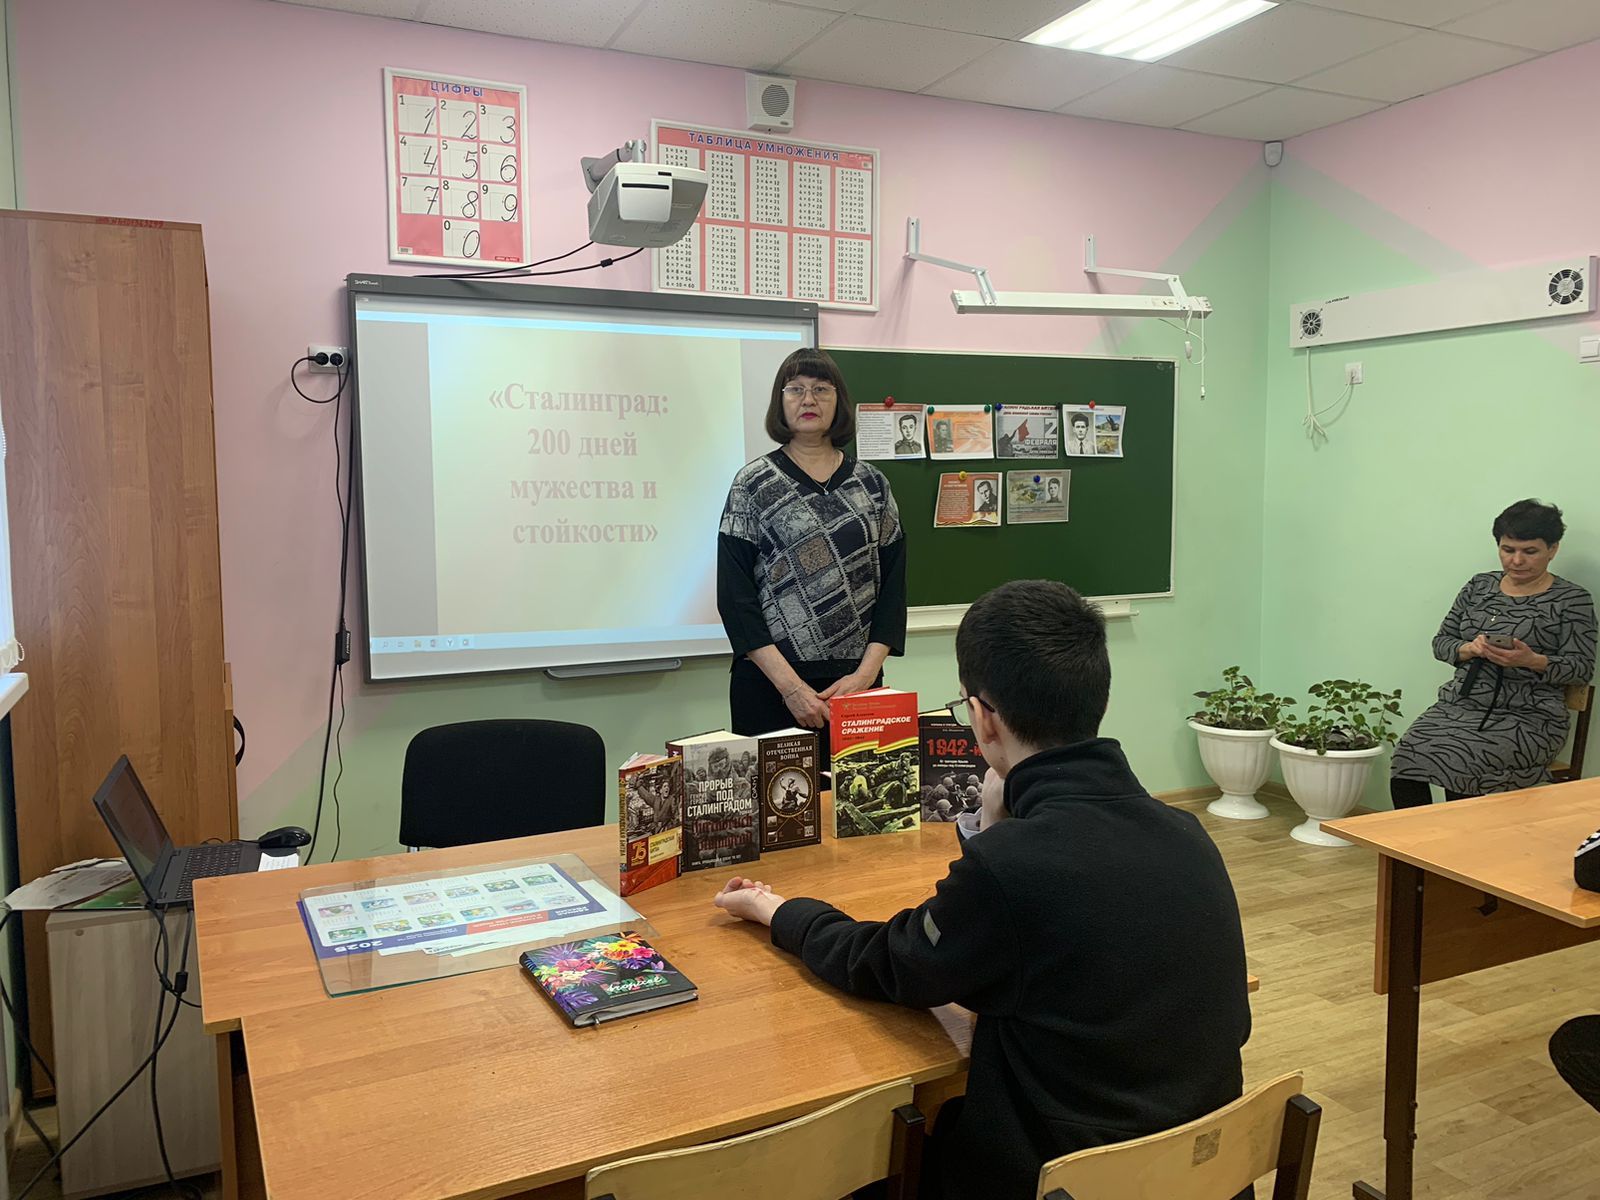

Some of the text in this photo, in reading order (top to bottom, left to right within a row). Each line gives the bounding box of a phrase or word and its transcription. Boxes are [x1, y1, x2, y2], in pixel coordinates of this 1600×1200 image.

[431, 81, 484, 97] ЦИФРЫ
[400, 95, 405, 105] 1
[440, 100, 447, 110] 2
[480, 105, 487, 115] 3
[424, 106, 437, 134] 1
[461, 110, 478, 140] 2
[500, 115, 516, 144] 3
[400, 136, 407, 146] 4
[442, 140, 448, 150] 5
[481, 145, 488, 154] 6
[688, 132, 840, 161] ТАБЛИЦА УМНОЖЕНИЯ
[424, 145, 438, 175] 4
[462, 151, 478, 179] 5
[500, 155, 517, 183] 6
[402, 177, 408, 186] 7
[442, 180, 449, 190] 8
[482, 184, 488, 194] 9
[424, 185, 439, 215] 7
[462, 191, 478, 218] 8
[501, 194, 518, 222] 9
[444, 221, 450, 230] 0
[462, 230, 480, 258] 0
[489, 383, 669, 421] «Сталинград:
[1044, 418, 1057, 438] 2
[528, 428, 638, 460] 200 дней
[510, 476, 657, 504] мужества и
[512, 517, 659, 545] стойкости»
[841, 716, 911, 727] СТАЛИНГРАДСКОЕ
[842, 726, 884, 735] СРАЖЕНИЕ
[766, 746, 812, 756] ОТЕЧЕСТВЕННАЯ
[698, 778, 733, 792] ПРОРЫВ
[716, 789, 734, 801] ПОД
[687, 798, 752, 817] СТАЛИНГРАДОМ
[334, 941, 383, 952] 2025
